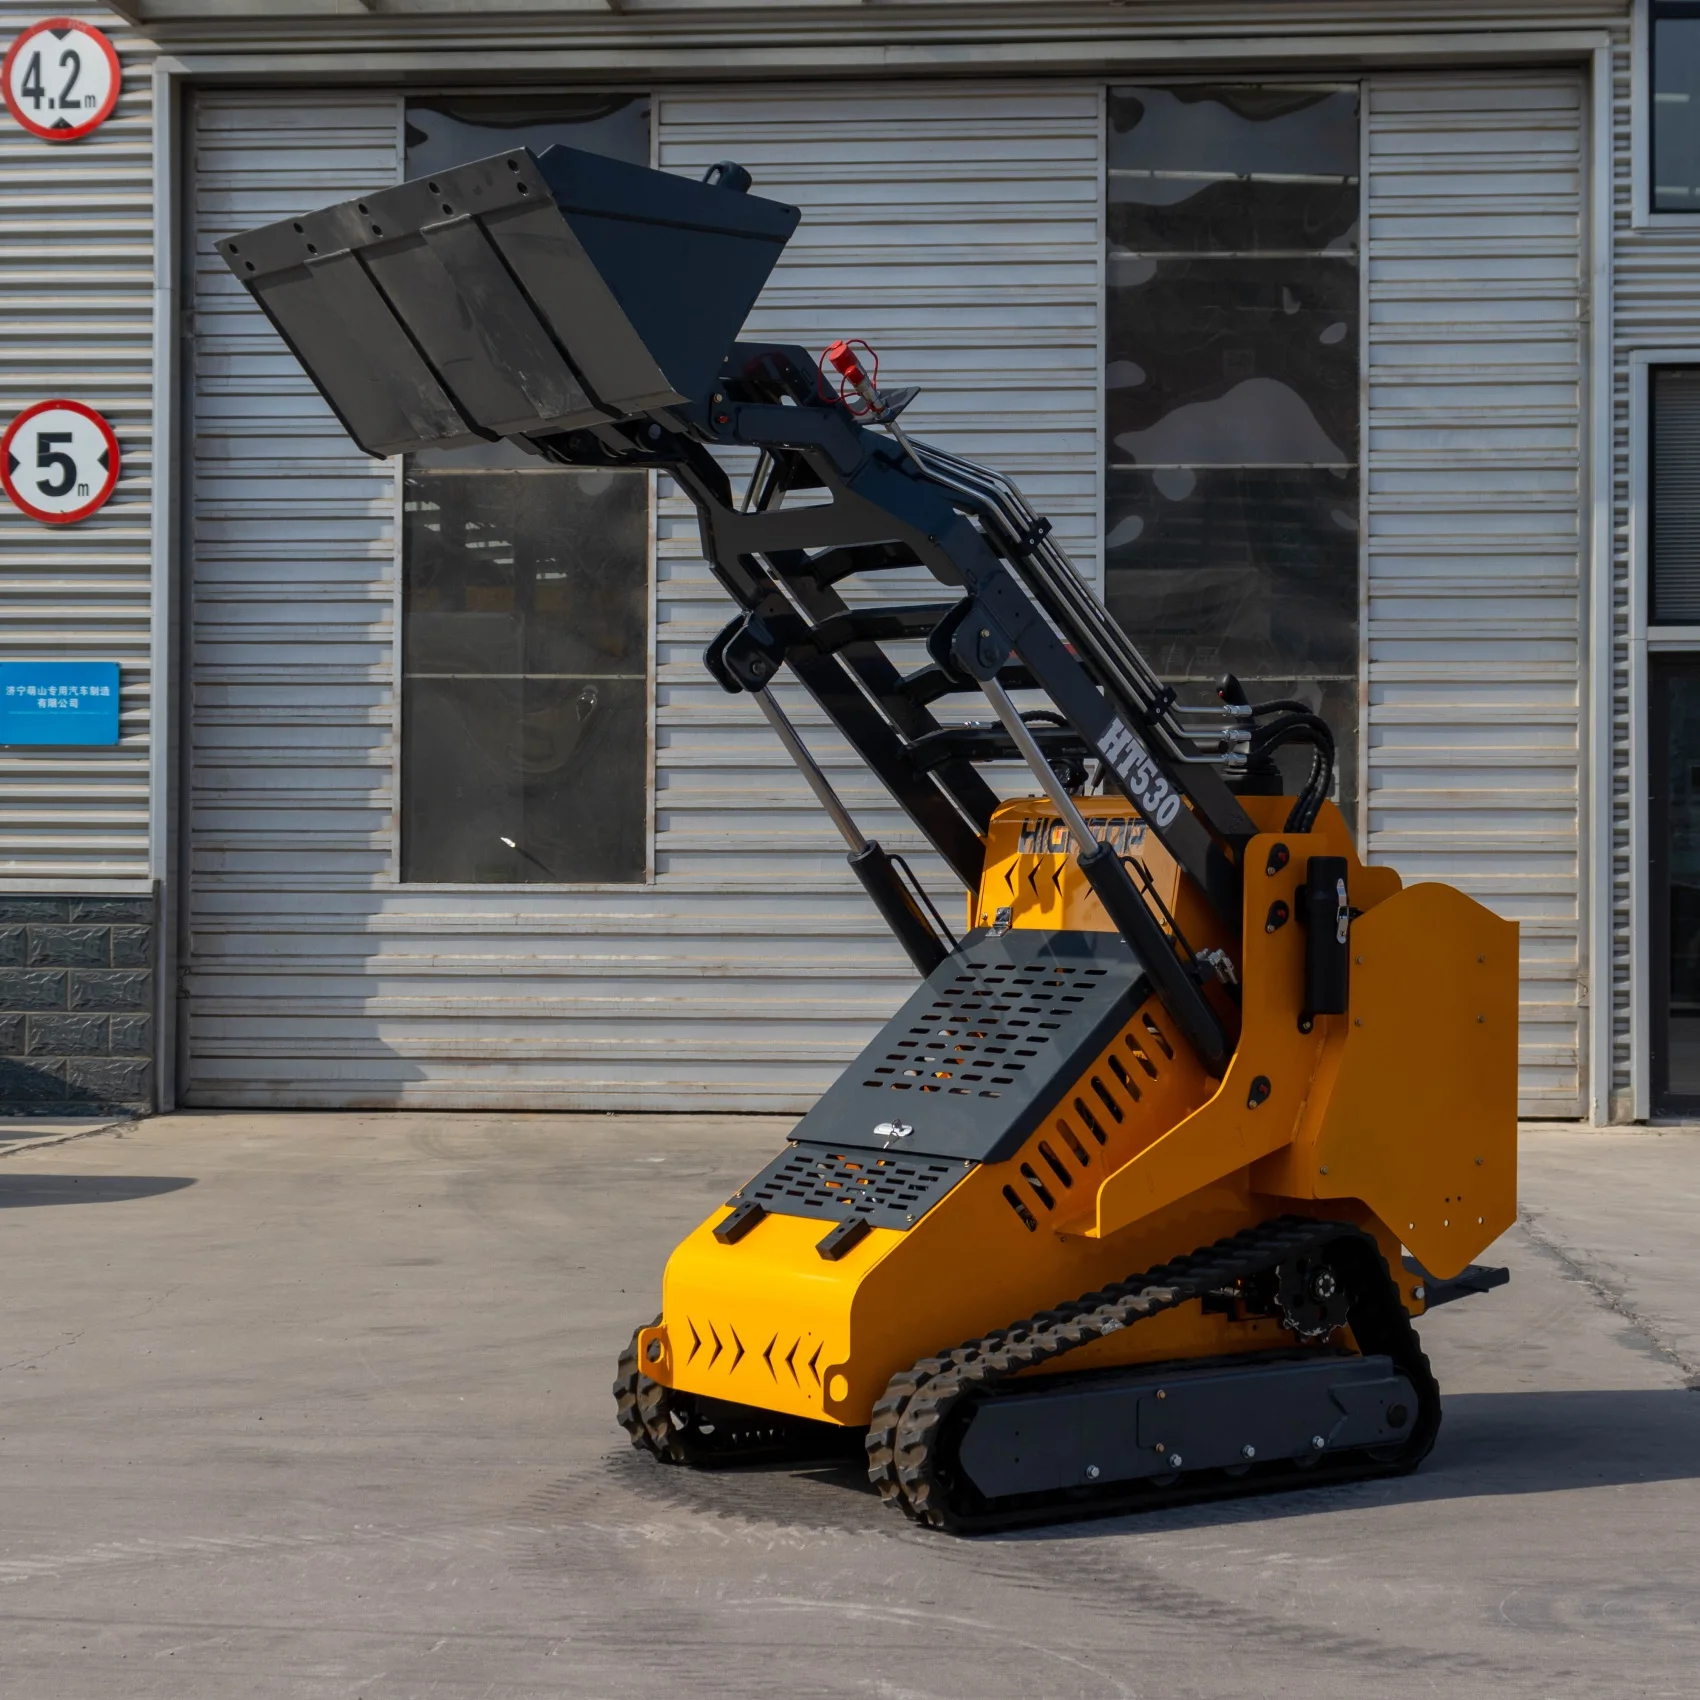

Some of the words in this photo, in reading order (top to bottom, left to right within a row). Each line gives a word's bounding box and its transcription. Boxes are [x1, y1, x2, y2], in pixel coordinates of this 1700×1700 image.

[37, 698, 79, 709] 有限公司
[1097, 717, 1180, 827] HT530
